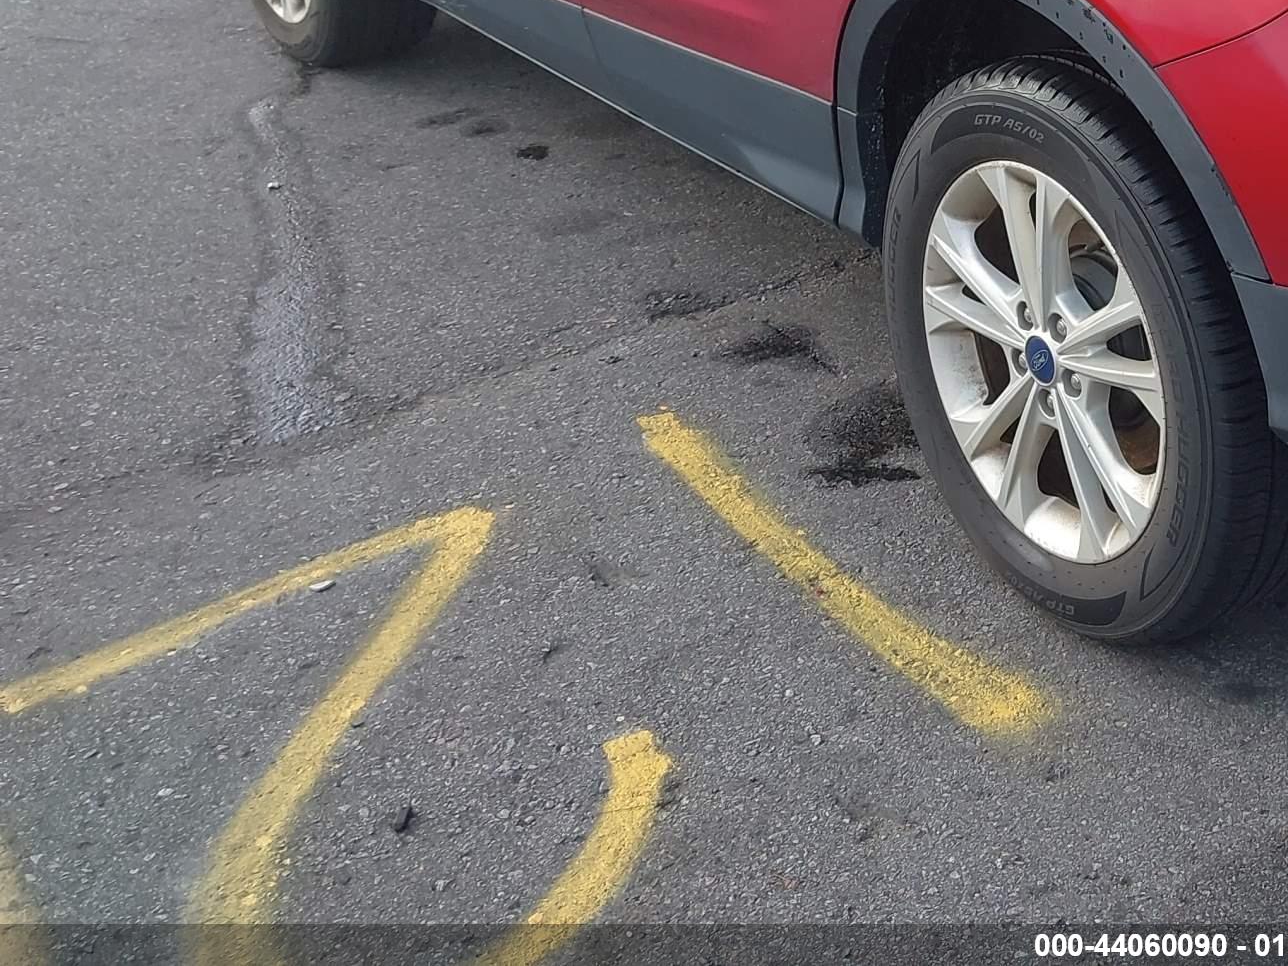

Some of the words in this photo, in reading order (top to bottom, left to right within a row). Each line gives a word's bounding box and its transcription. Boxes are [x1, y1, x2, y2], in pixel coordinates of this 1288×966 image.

[974, 114, 1002, 126] GTP
[1003, 118, 1045, 143] AS/02
[1166, 410, 1192, 548] HUGGER
